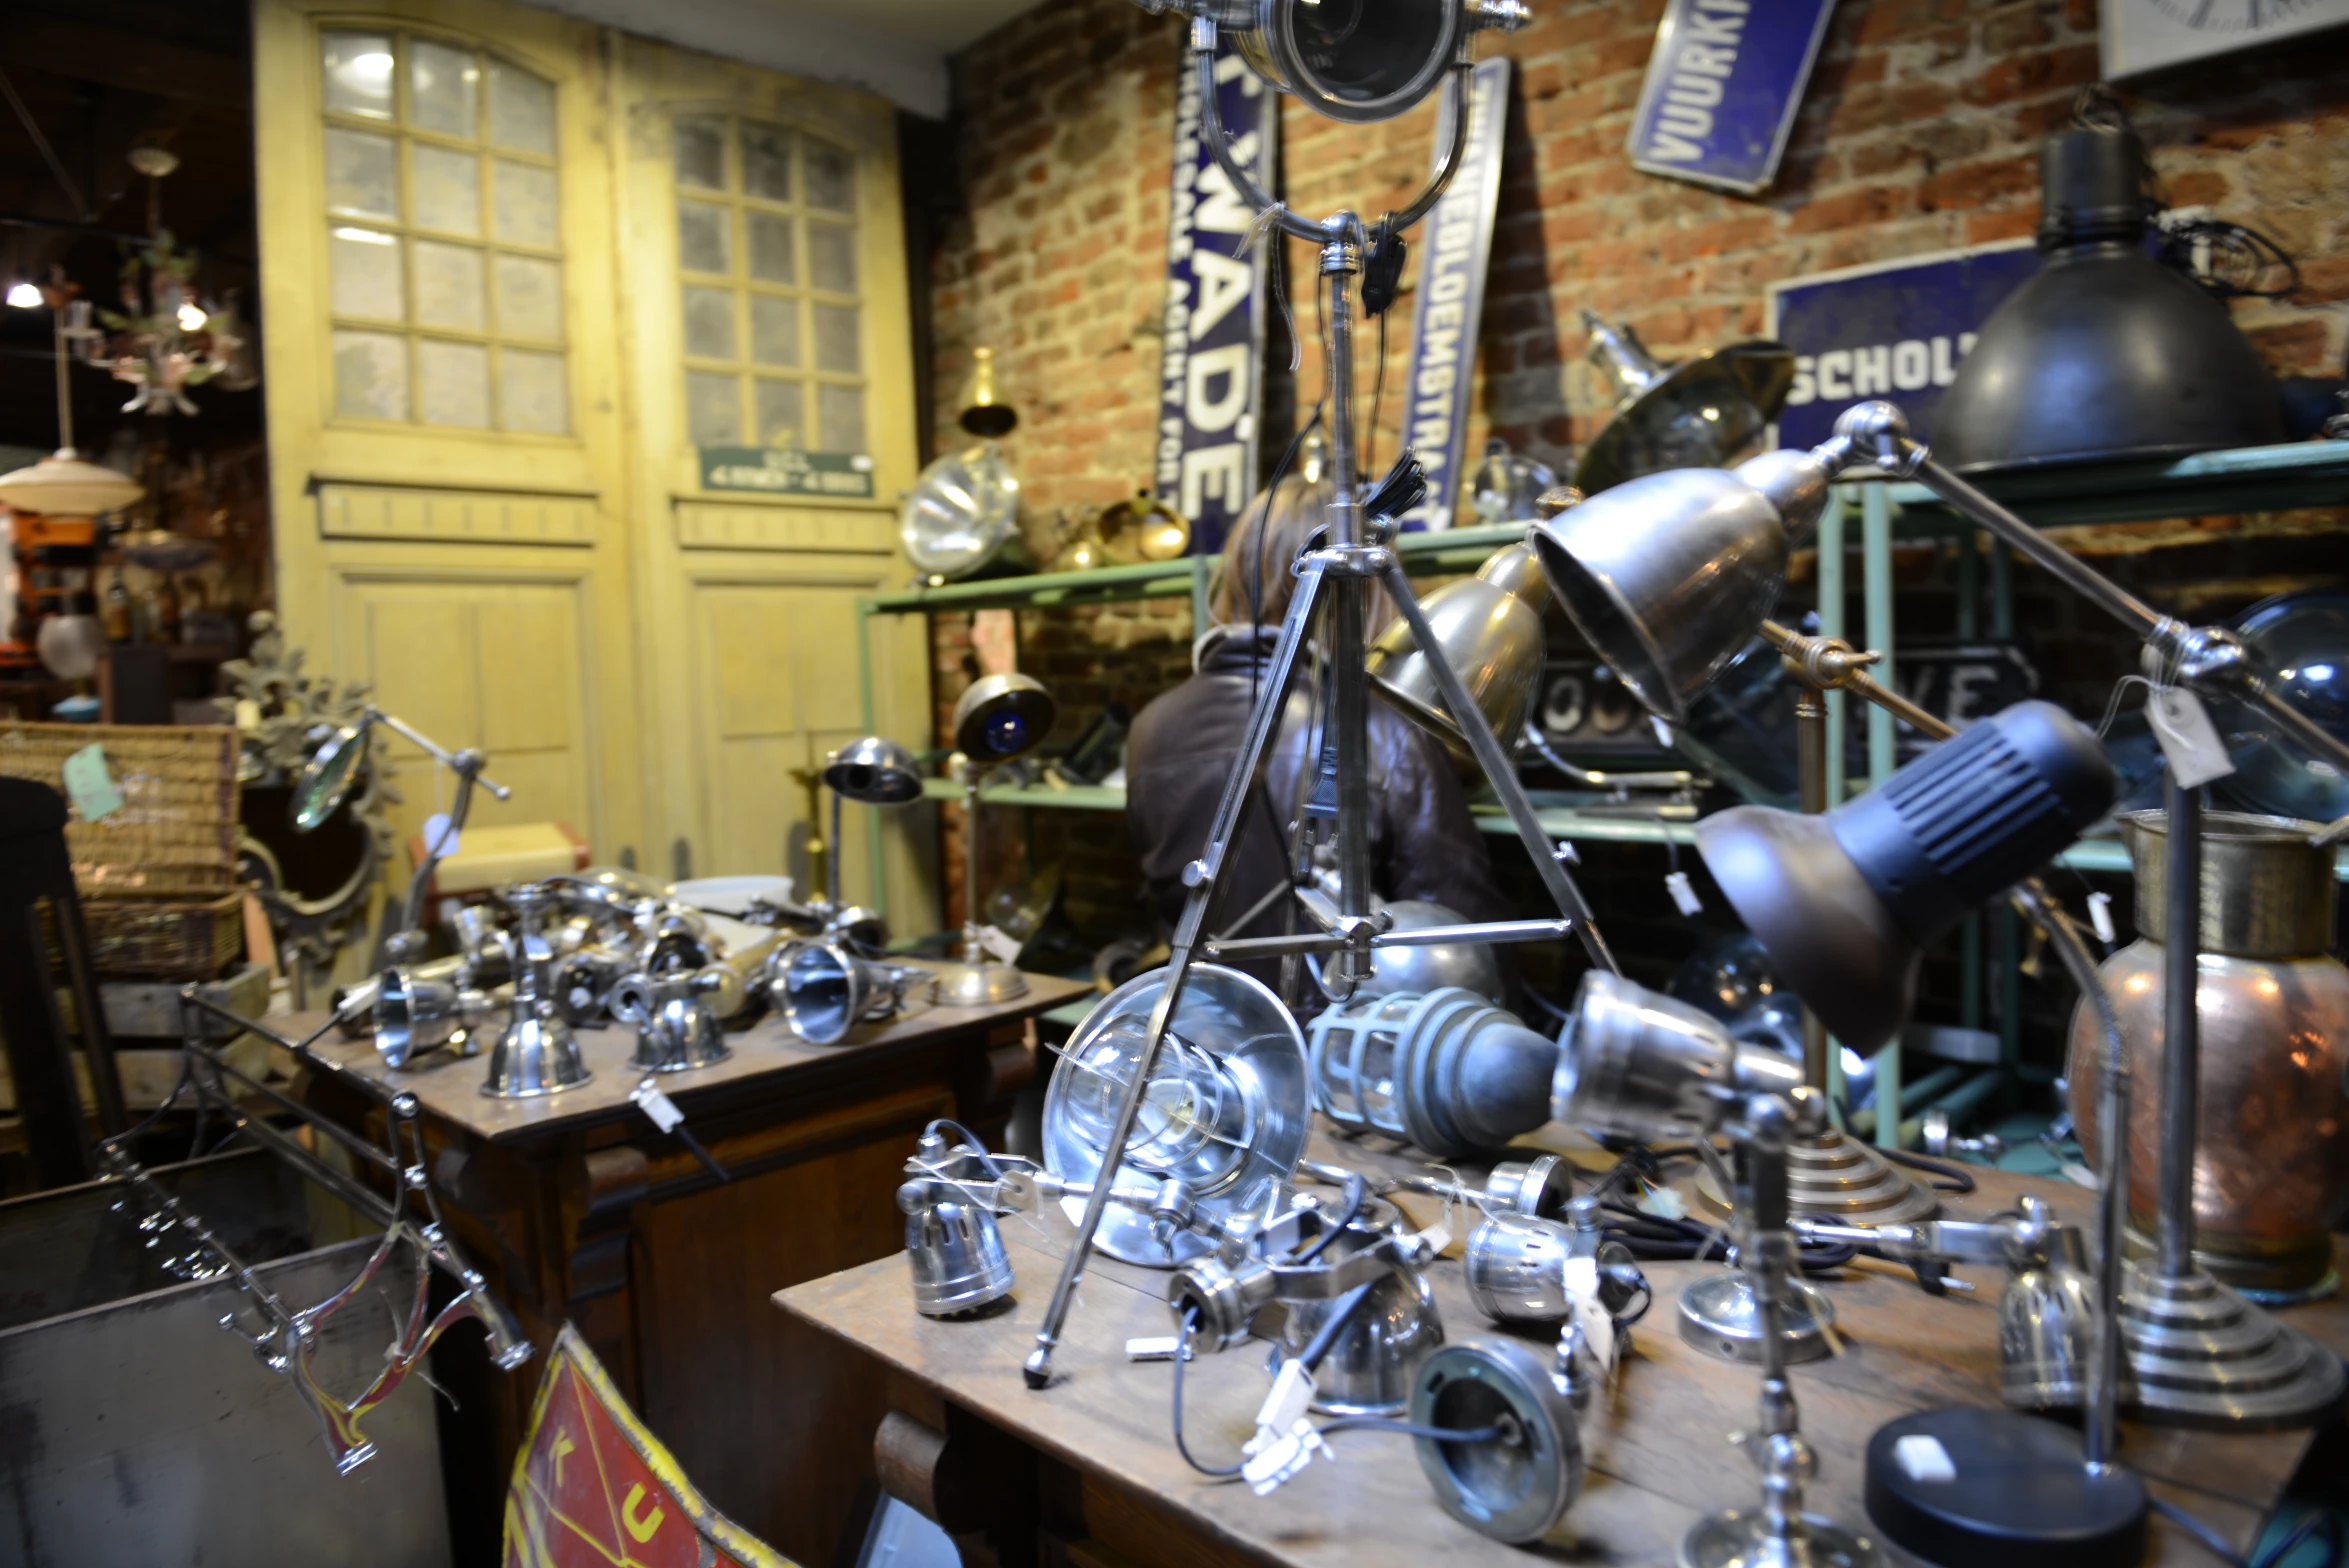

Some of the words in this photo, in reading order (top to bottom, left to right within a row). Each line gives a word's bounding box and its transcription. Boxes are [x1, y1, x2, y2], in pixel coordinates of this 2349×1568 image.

[1162, 278, 1192, 408] AGENT
[1182, 131, 1264, 520] WADE
[1158, 417, 1183, 485] FOR
